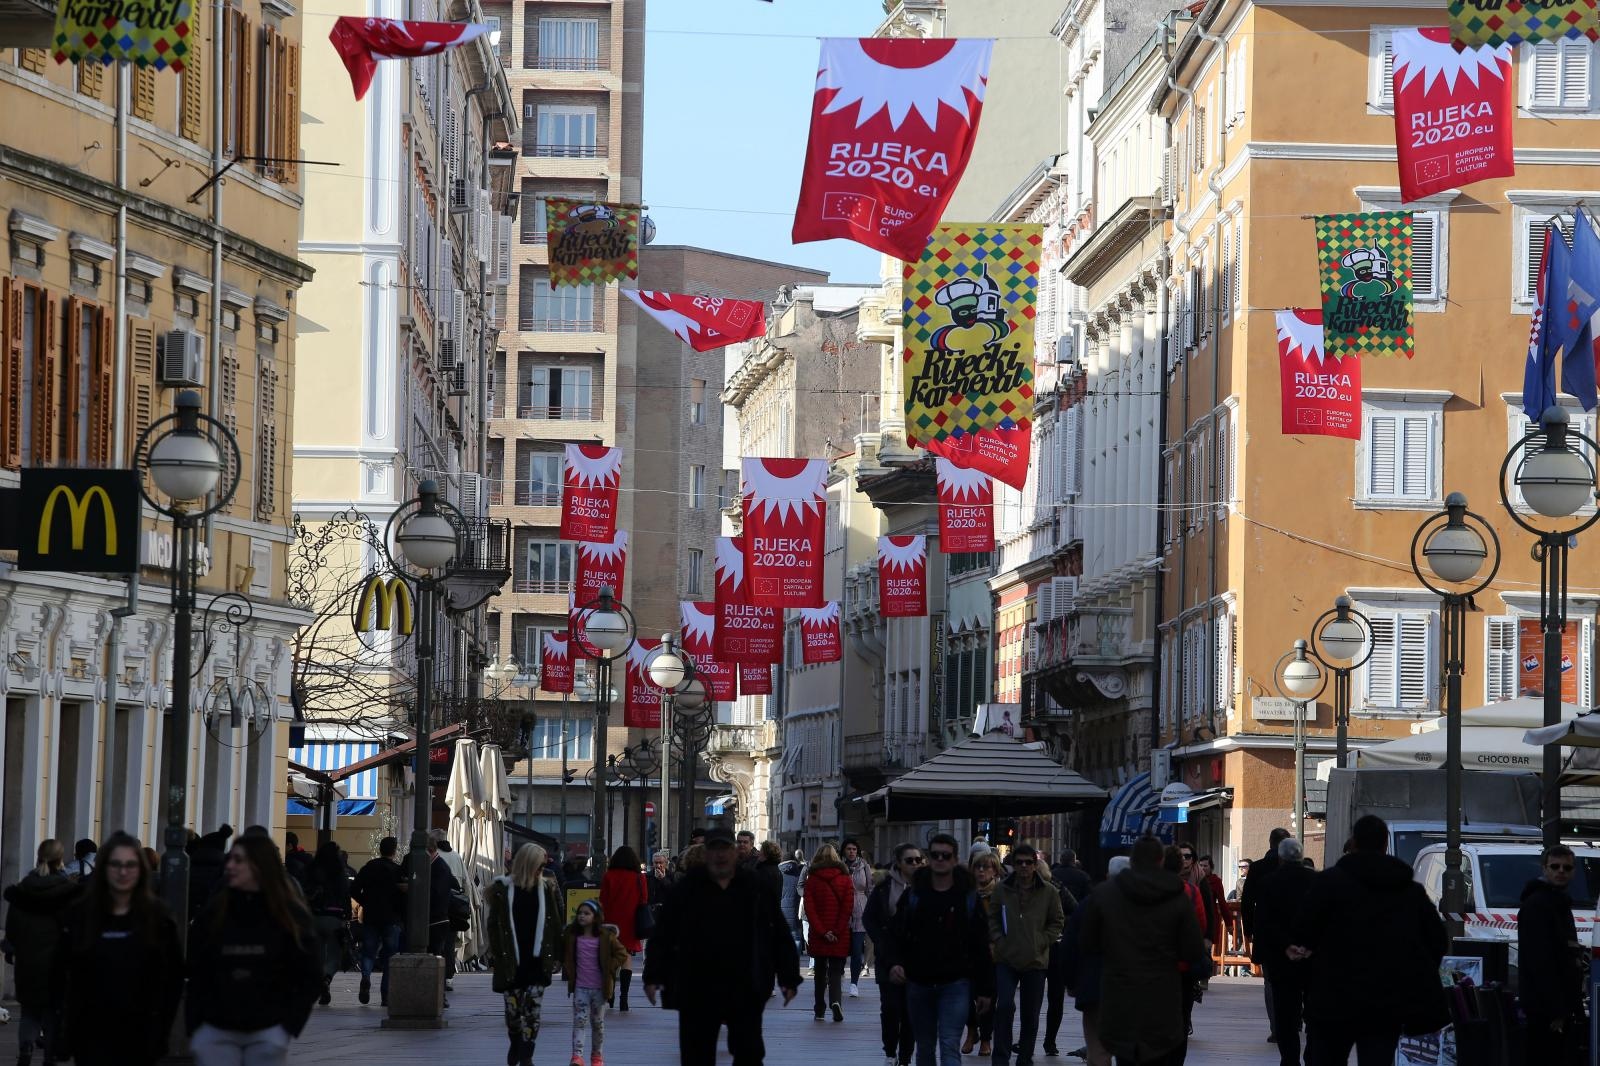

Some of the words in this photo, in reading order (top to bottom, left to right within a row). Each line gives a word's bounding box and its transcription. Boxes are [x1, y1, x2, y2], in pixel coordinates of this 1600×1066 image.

[1411, 101, 1494, 130] RIJEKA
[1411, 121, 1494, 148] 2020.eu
[1455, 145, 1494, 158] EUROPEAN
[830, 142, 949, 176] RIJEKA
[1455, 154, 1484, 166] CAPITAL
[1484, 152, 1495, 160] OF
[1455, 161, 1488, 174] CULTURE
[1295, 372, 1352, 388] RIJEKA
[1295, 385, 1352, 402] 2020.eu
[979, 442, 1008, 457] CAPITAL
[571, 496, 610, 509] RIJEKA
[946, 508, 986, 518] RIJEKA
[946, 518, 987, 529] 2020.eu
[753, 538, 812, 552] RIJEKA
[753, 553, 812, 567] 2020.eu
[583, 570, 617, 580] RIJEKA
[887, 578, 920, 587] RIJEKA
[725, 604, 774, 617] RIJEKA
[723, 616, 775, 629] 2020.eu
[807, 632, 835, 640] RIJEKA
[546, 664, 570, 672] RIJEKA
[1477, 754, 1510, 764] CHOCO
[1511, 756, 1530, 765] BAR
